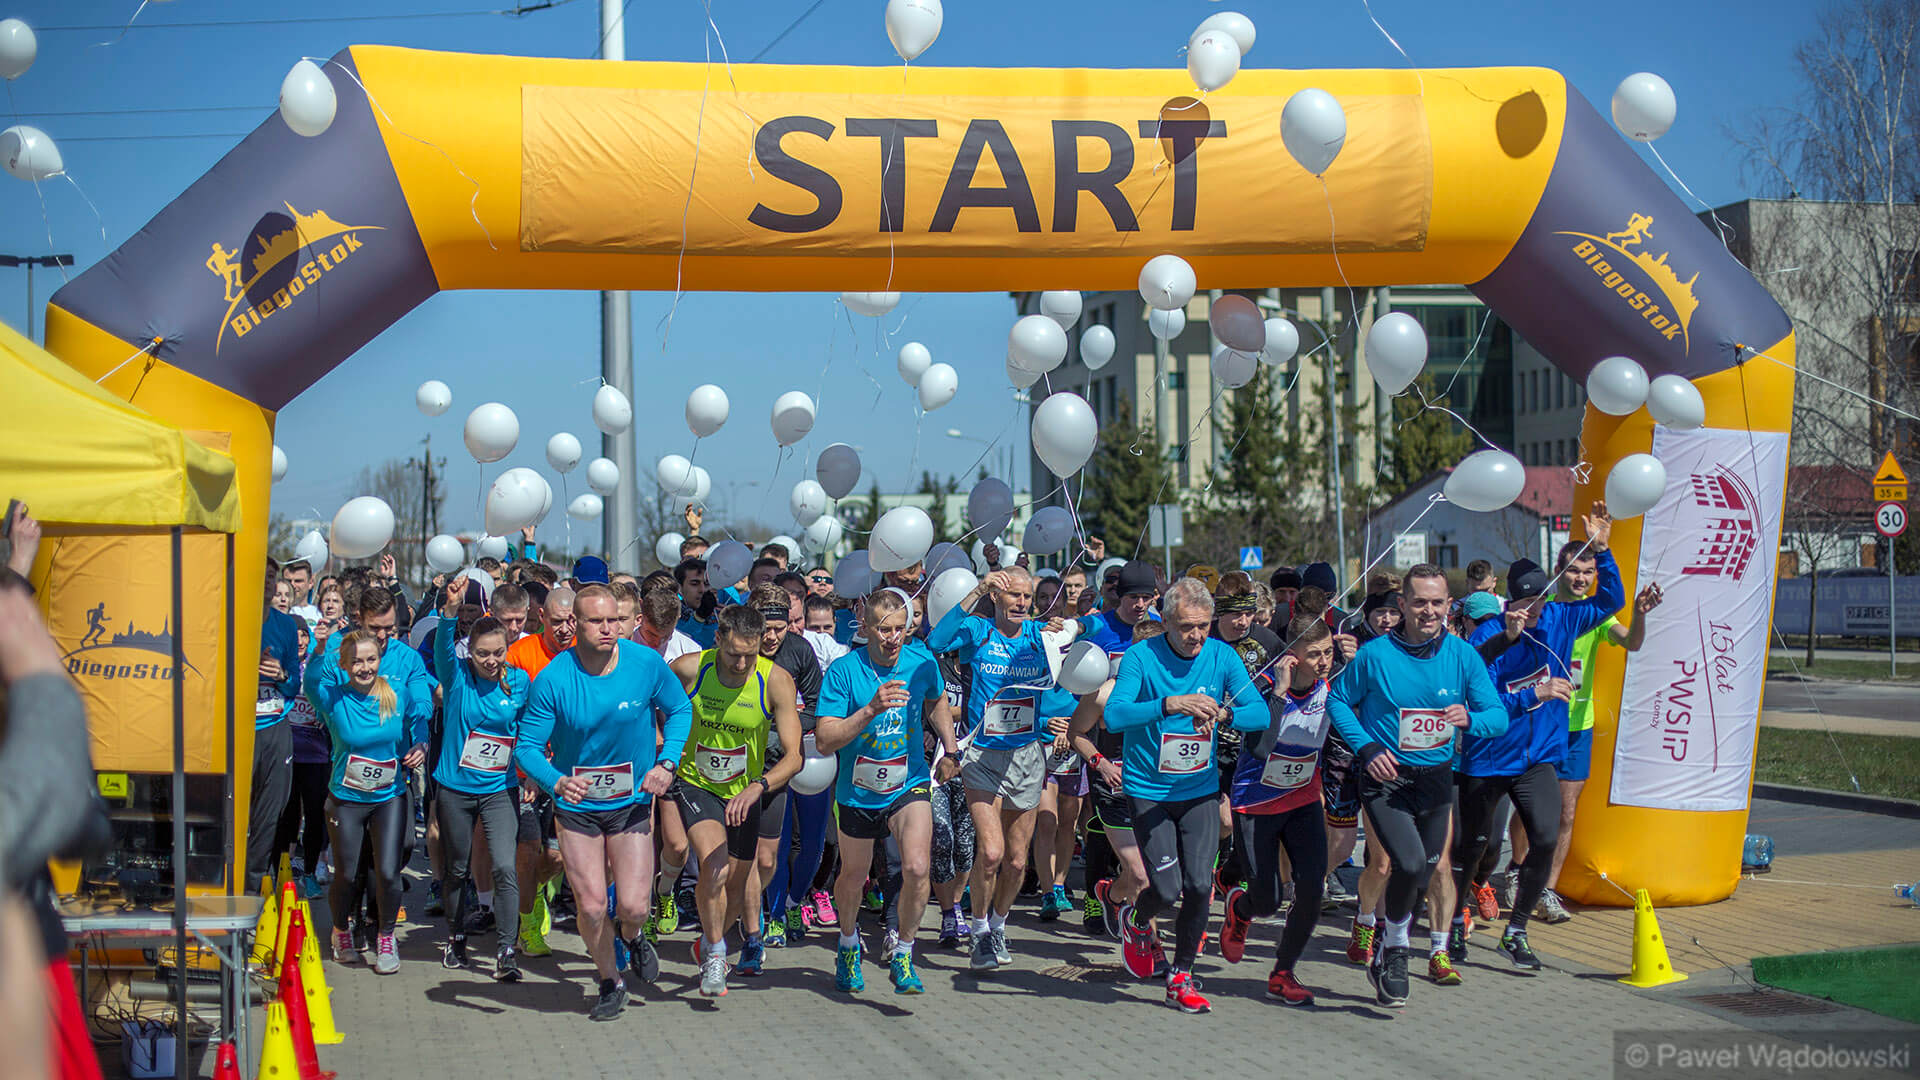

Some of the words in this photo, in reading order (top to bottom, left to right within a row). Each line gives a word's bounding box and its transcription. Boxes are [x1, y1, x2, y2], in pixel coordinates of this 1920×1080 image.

[747, 115, 1228, 233] START
[230, 232, 363, 338] BiegoStok
[1572, 240, 1682, 341] BiegoStok
[1880, 488, 1892, 498] 35
[1881, 511, 1903, 527] 30
[1846, 606, 1890, 619] OFFICE
[980, 662, 1039, 678] POZDRAWIAM
[1001, 707, 1021, 720] 77
[700, 719, 745, 734] KRZYCH
[1412, 718, 1446, 732] 206
[480, 742, 501, 756] 27
[1178, 742, 1200, 756] 39
[710, 756, 731, 768] 87
[1282, 763, 1304, 775] 19
[362, 766, 383, 778] 58
[876, 767, 888, 779] 8
[592, 773, 616, 786] 75
